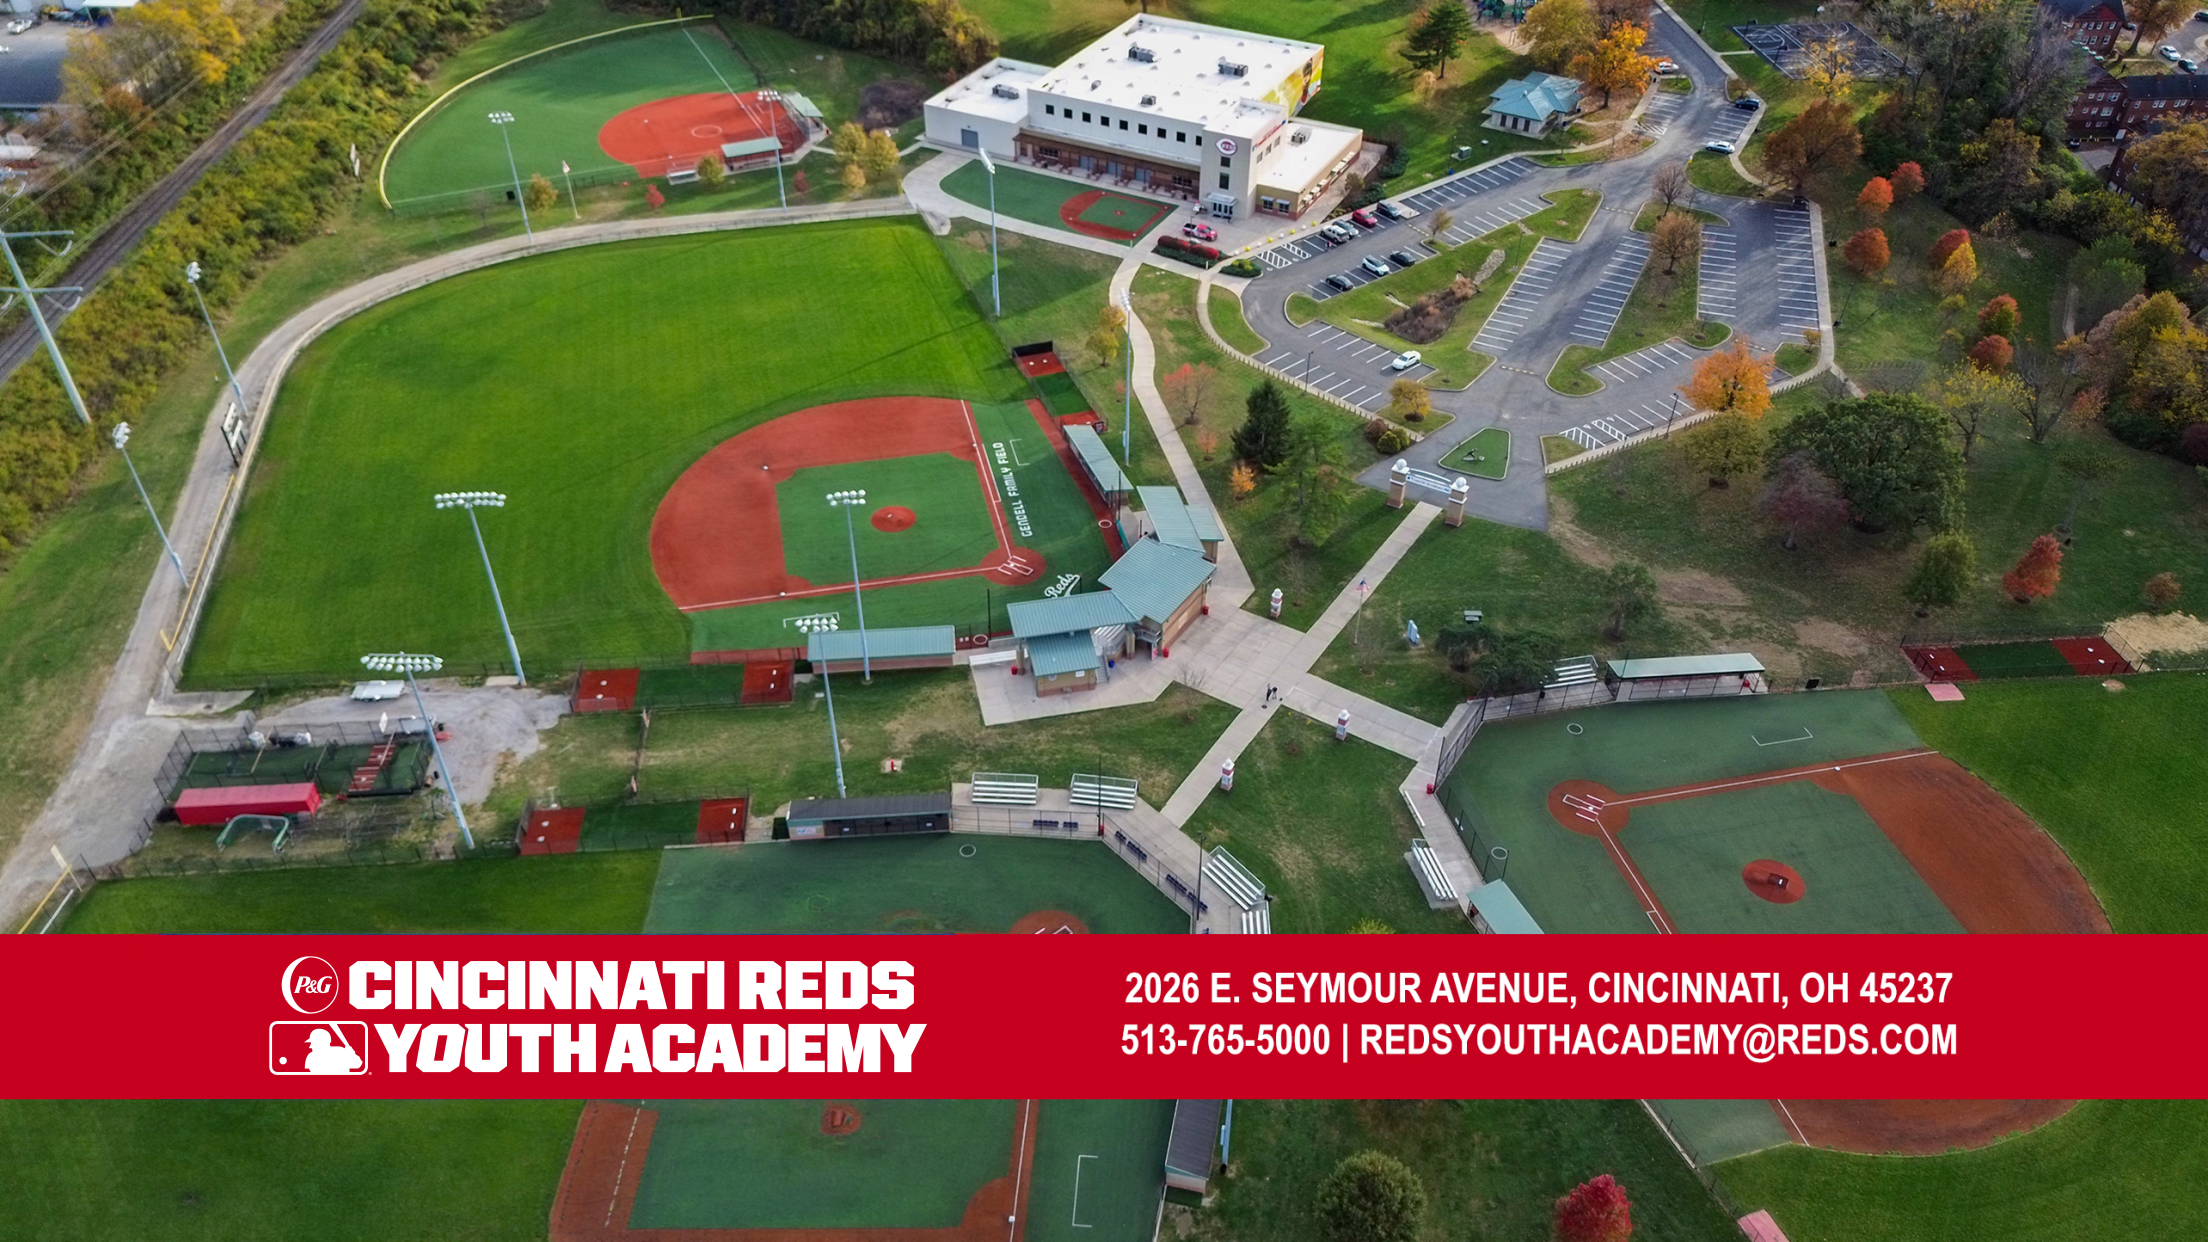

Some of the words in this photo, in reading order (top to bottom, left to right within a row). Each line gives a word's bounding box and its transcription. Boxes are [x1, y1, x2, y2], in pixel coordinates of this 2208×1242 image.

[992, 442, 1009, 464] FIELD
[1000, 467, 1019, 497] FAMILY
[1012, 500, 1033, 537] GENDELL
[1044, 574, 1080, 599] Reds
